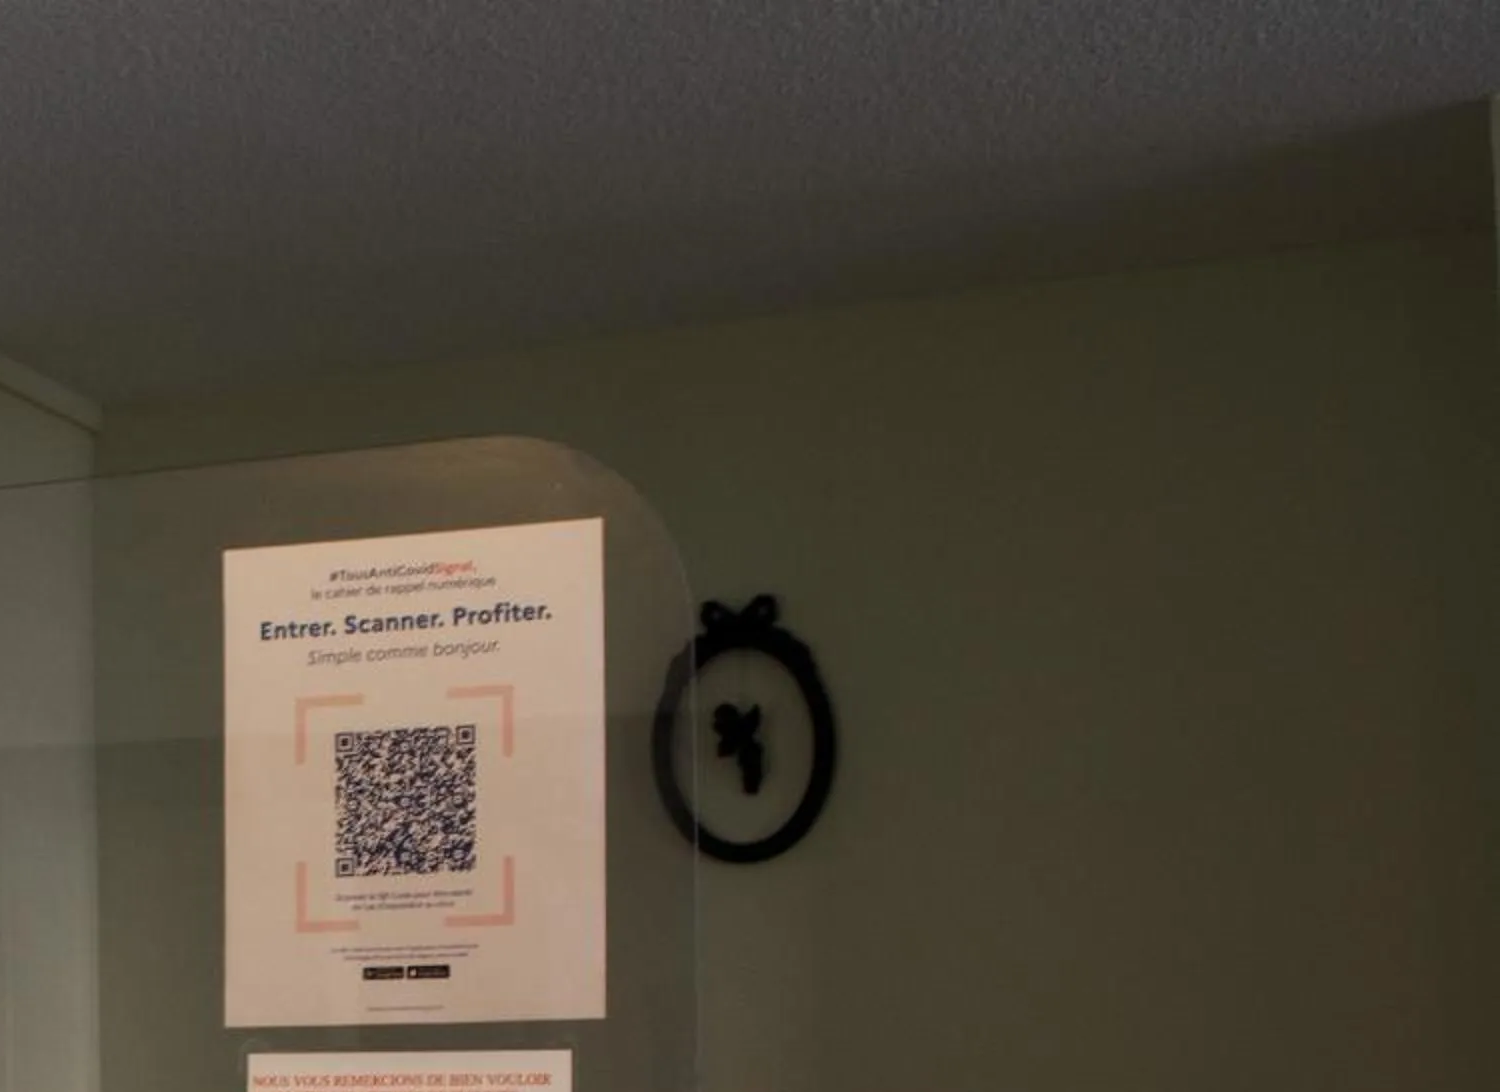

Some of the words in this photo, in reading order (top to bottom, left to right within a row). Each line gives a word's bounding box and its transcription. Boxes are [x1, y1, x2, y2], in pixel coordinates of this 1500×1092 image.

[260, 620, 337, 641] Entrer.
[344, 612, 445, 635] Scanner.
[453, 602, 553, 627] Profiter.
[307, 648, 362, 666] Simple
[366, 645, 429, 662] comme
[433, 638, 501, 660] bonjour.
